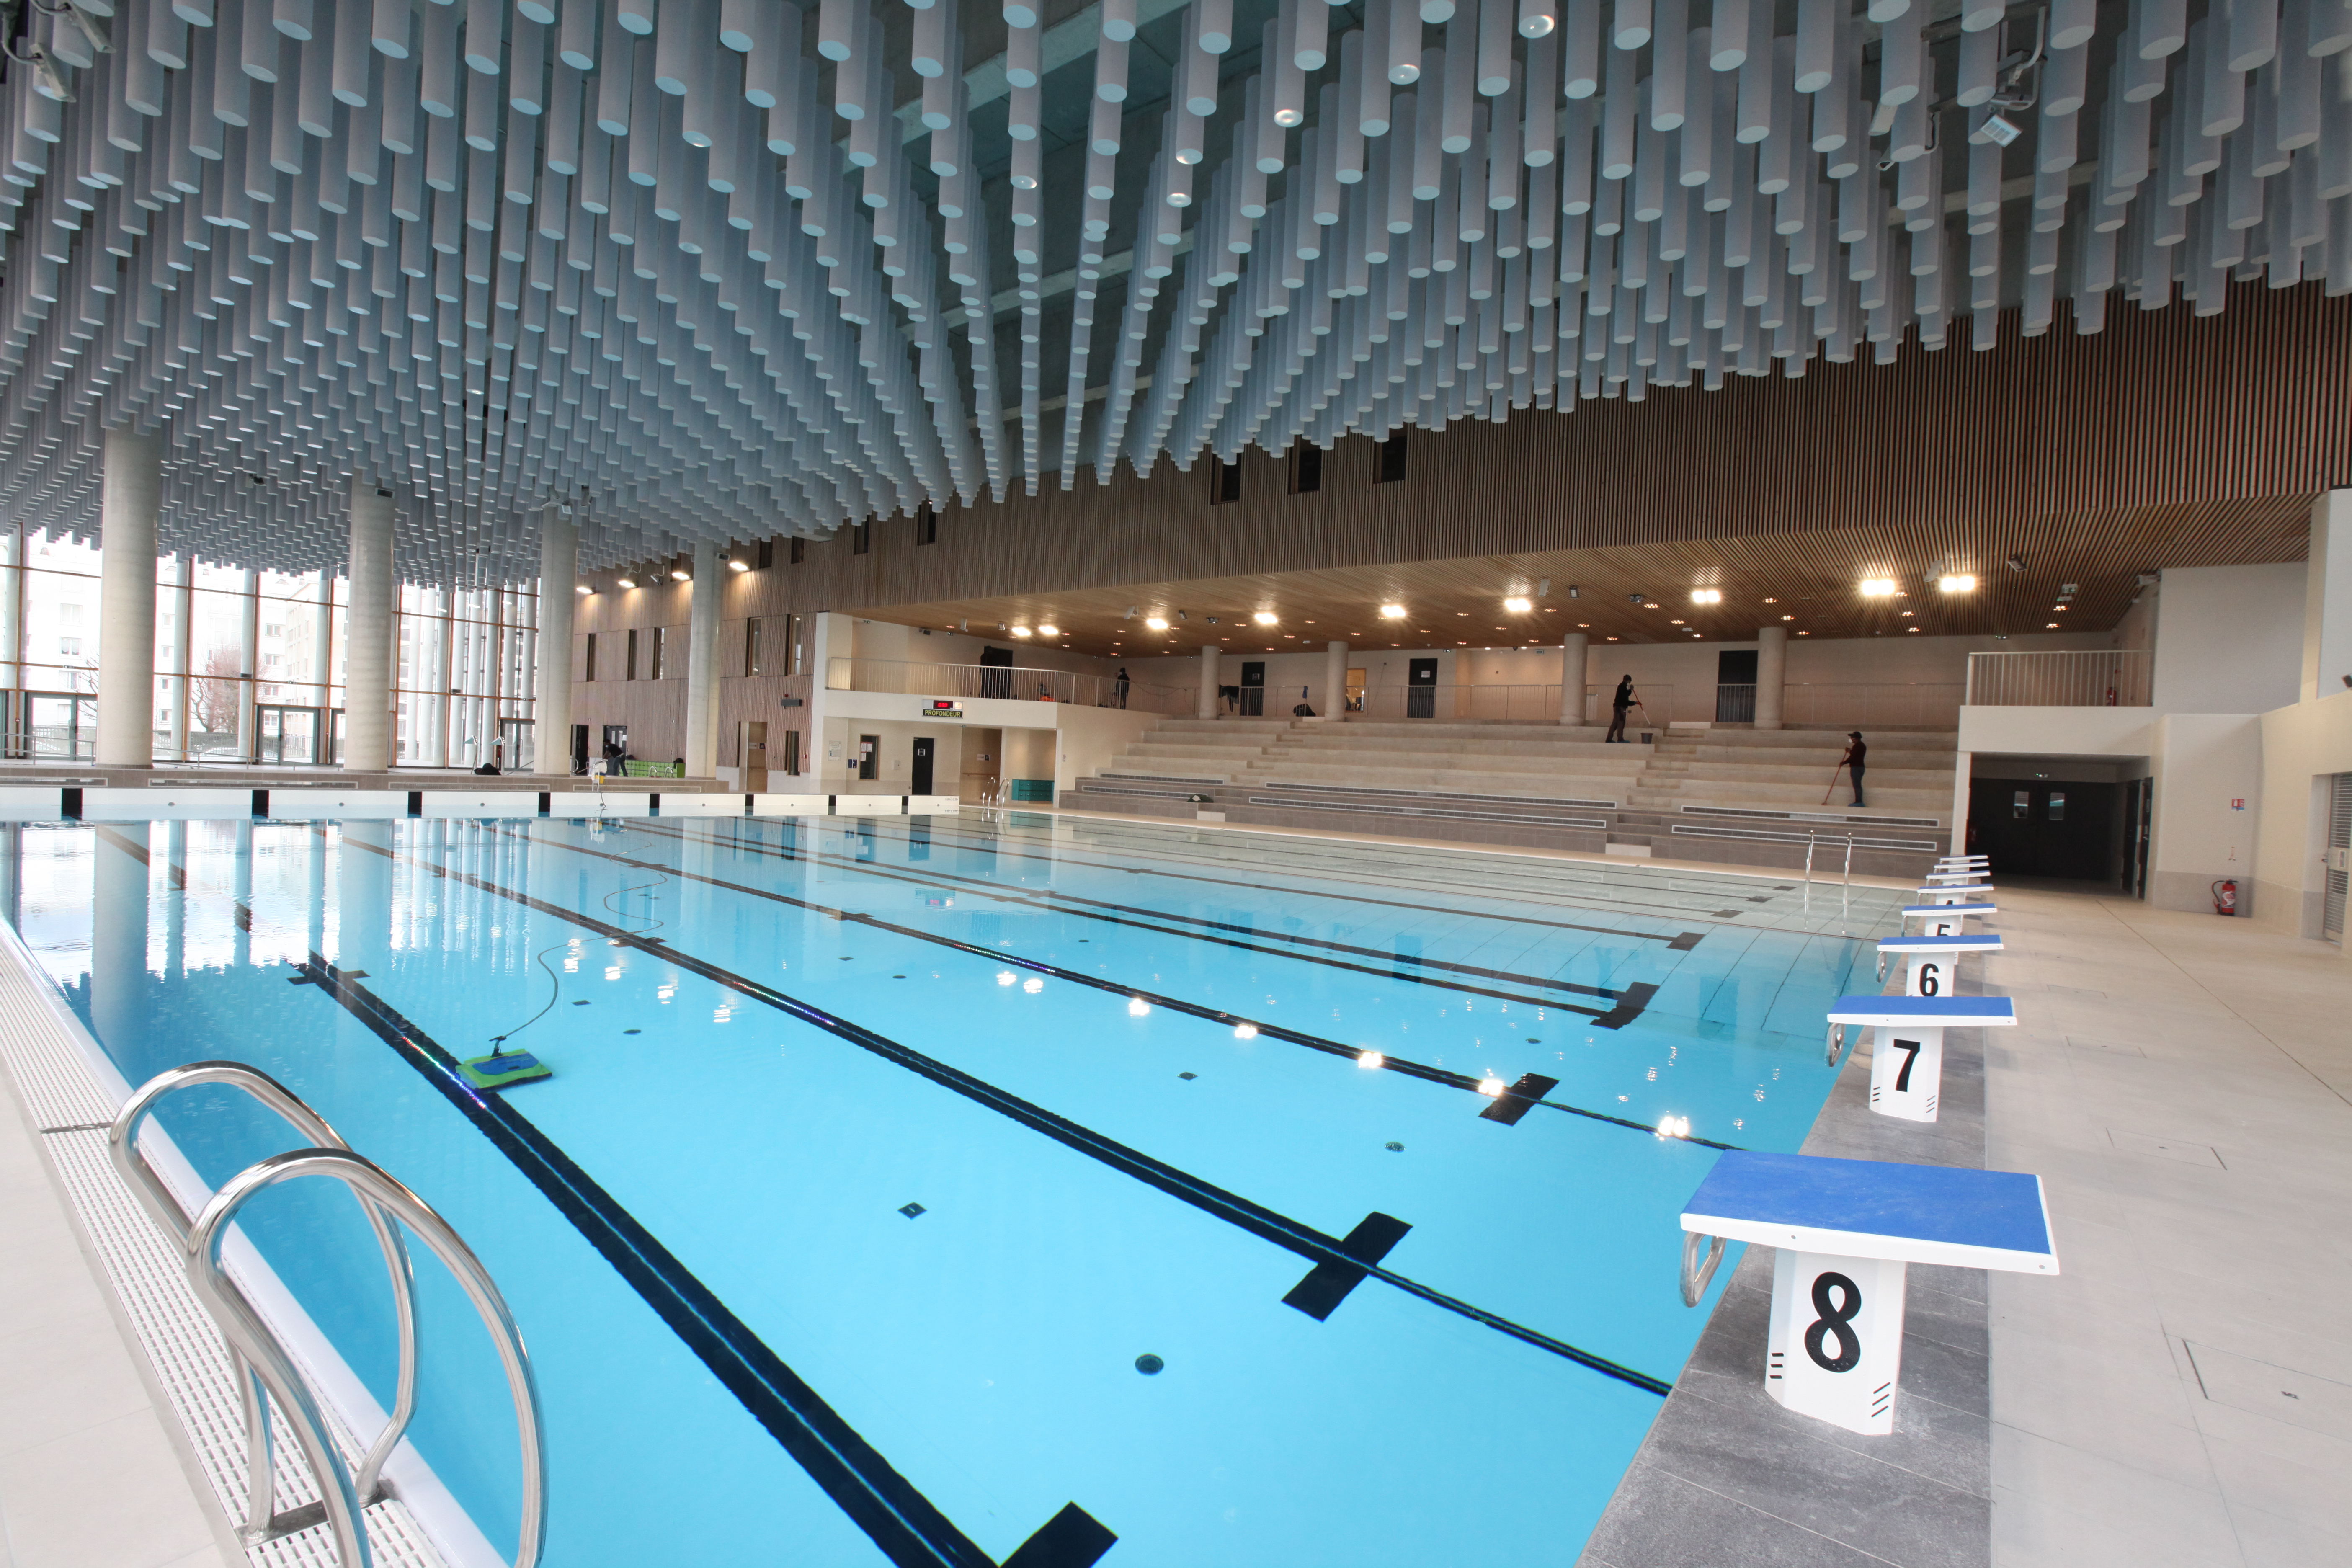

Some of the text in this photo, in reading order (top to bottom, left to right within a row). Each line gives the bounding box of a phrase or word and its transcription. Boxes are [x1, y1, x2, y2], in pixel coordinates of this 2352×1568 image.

[1920, 963, 1939, 996] 6
[1894, 1039, 1920, 1092] 7
[1805, 1272, 1861, 1372] 8
